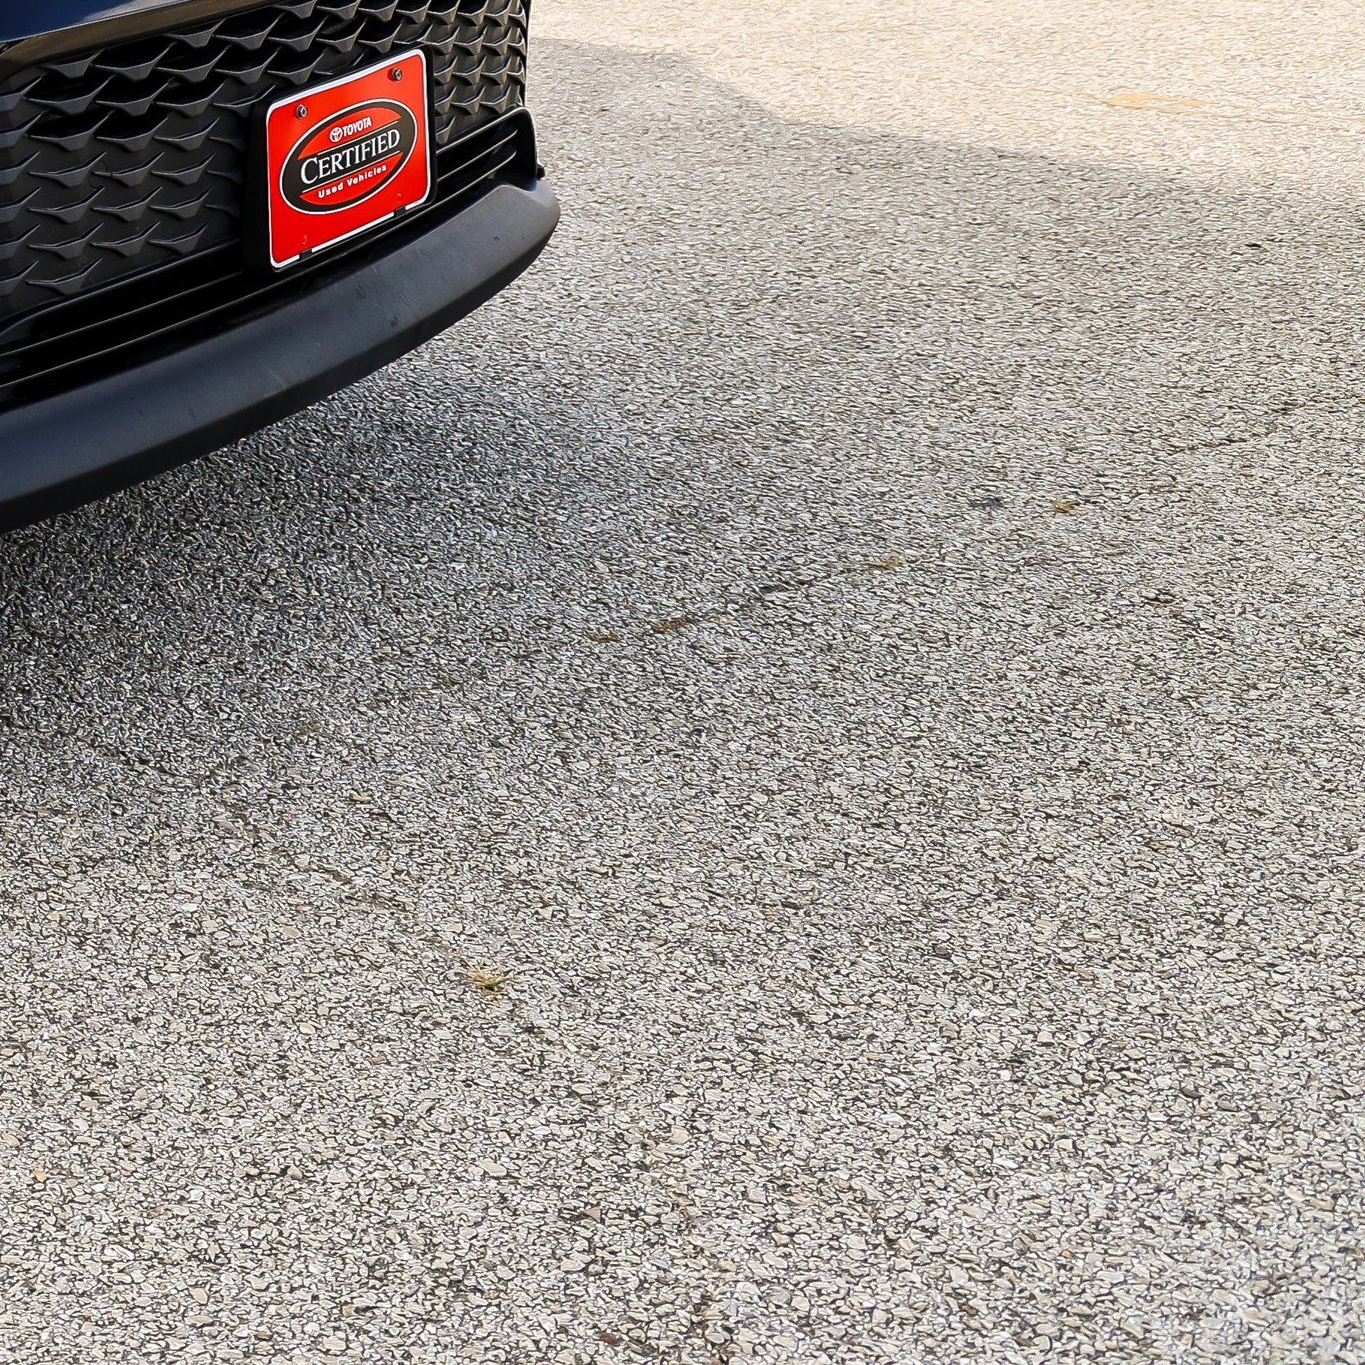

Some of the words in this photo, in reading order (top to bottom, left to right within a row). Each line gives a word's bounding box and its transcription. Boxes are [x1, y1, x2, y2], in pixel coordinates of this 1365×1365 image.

[343, 116, 372, 137] TOYOTA
[300, 129, 401, 185] CERTIFIED
[318, 181, 344, 198] Used
[347, 164, 387, 186] Vehicles
